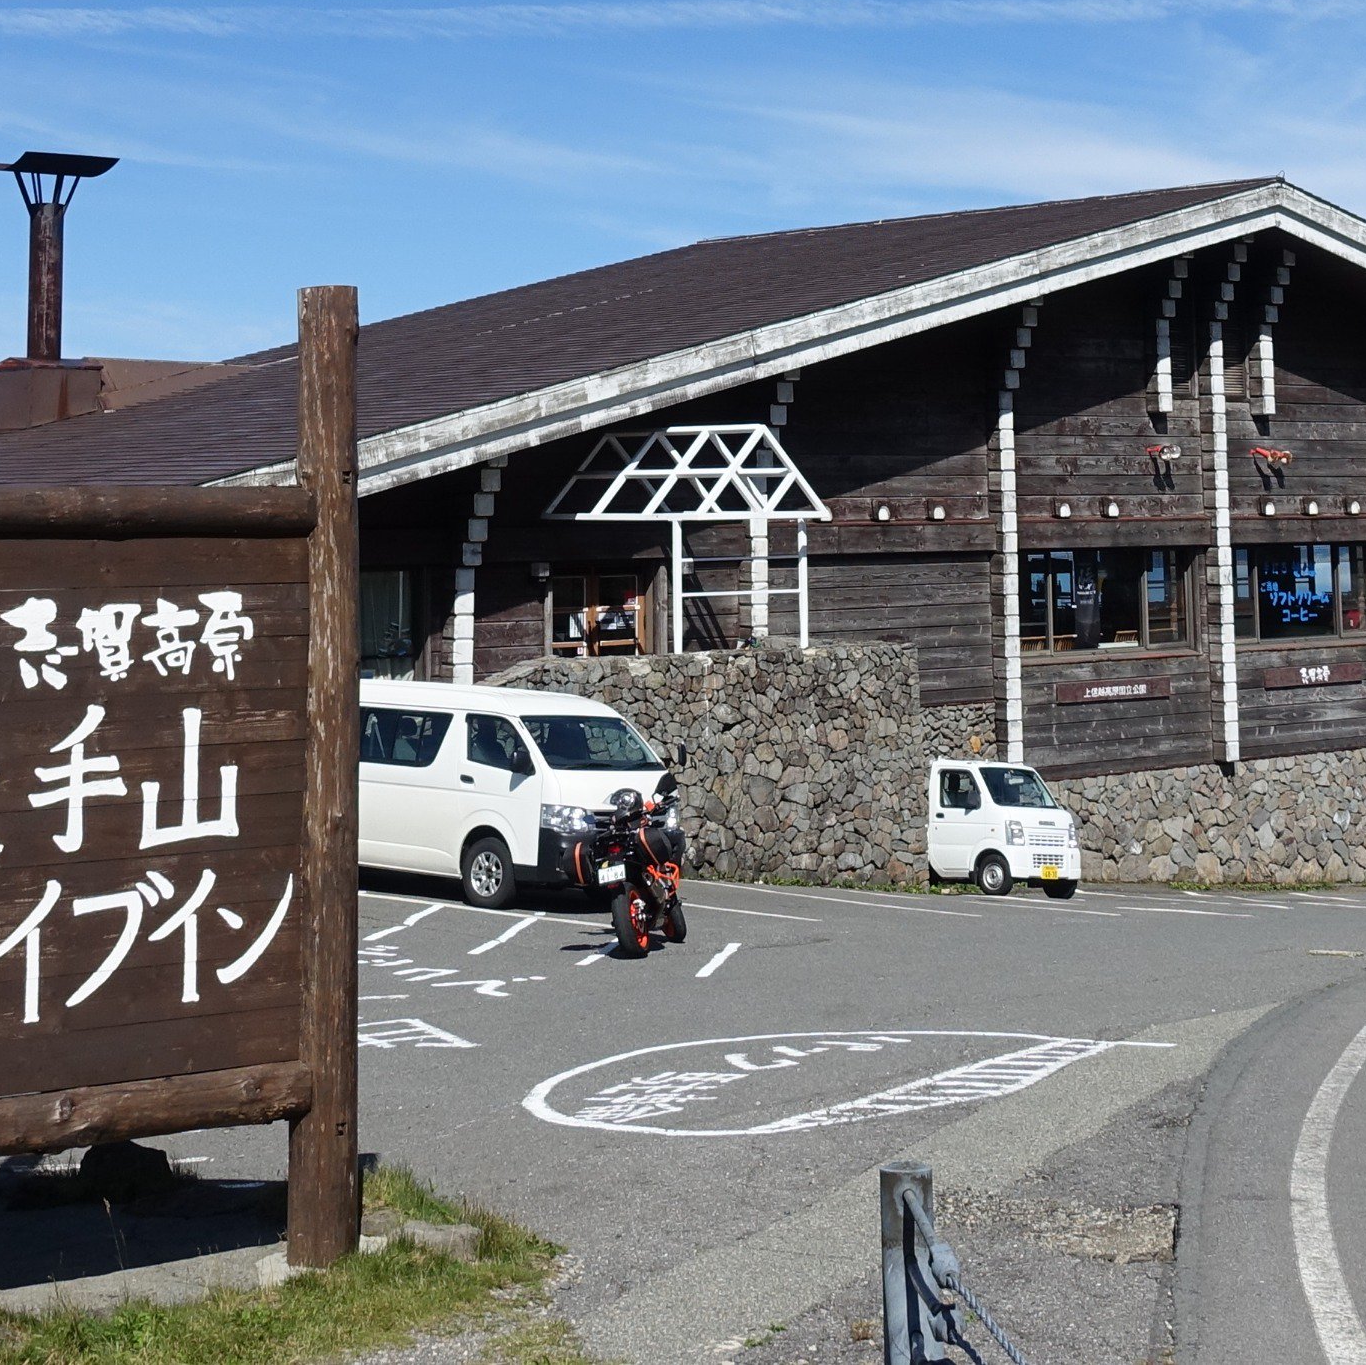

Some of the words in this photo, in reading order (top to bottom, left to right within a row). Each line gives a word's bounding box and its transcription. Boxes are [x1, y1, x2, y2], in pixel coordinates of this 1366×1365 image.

[0, 591, 253, 690] 志賀高原
[1282, 607, 1318, 622] コーヒー
